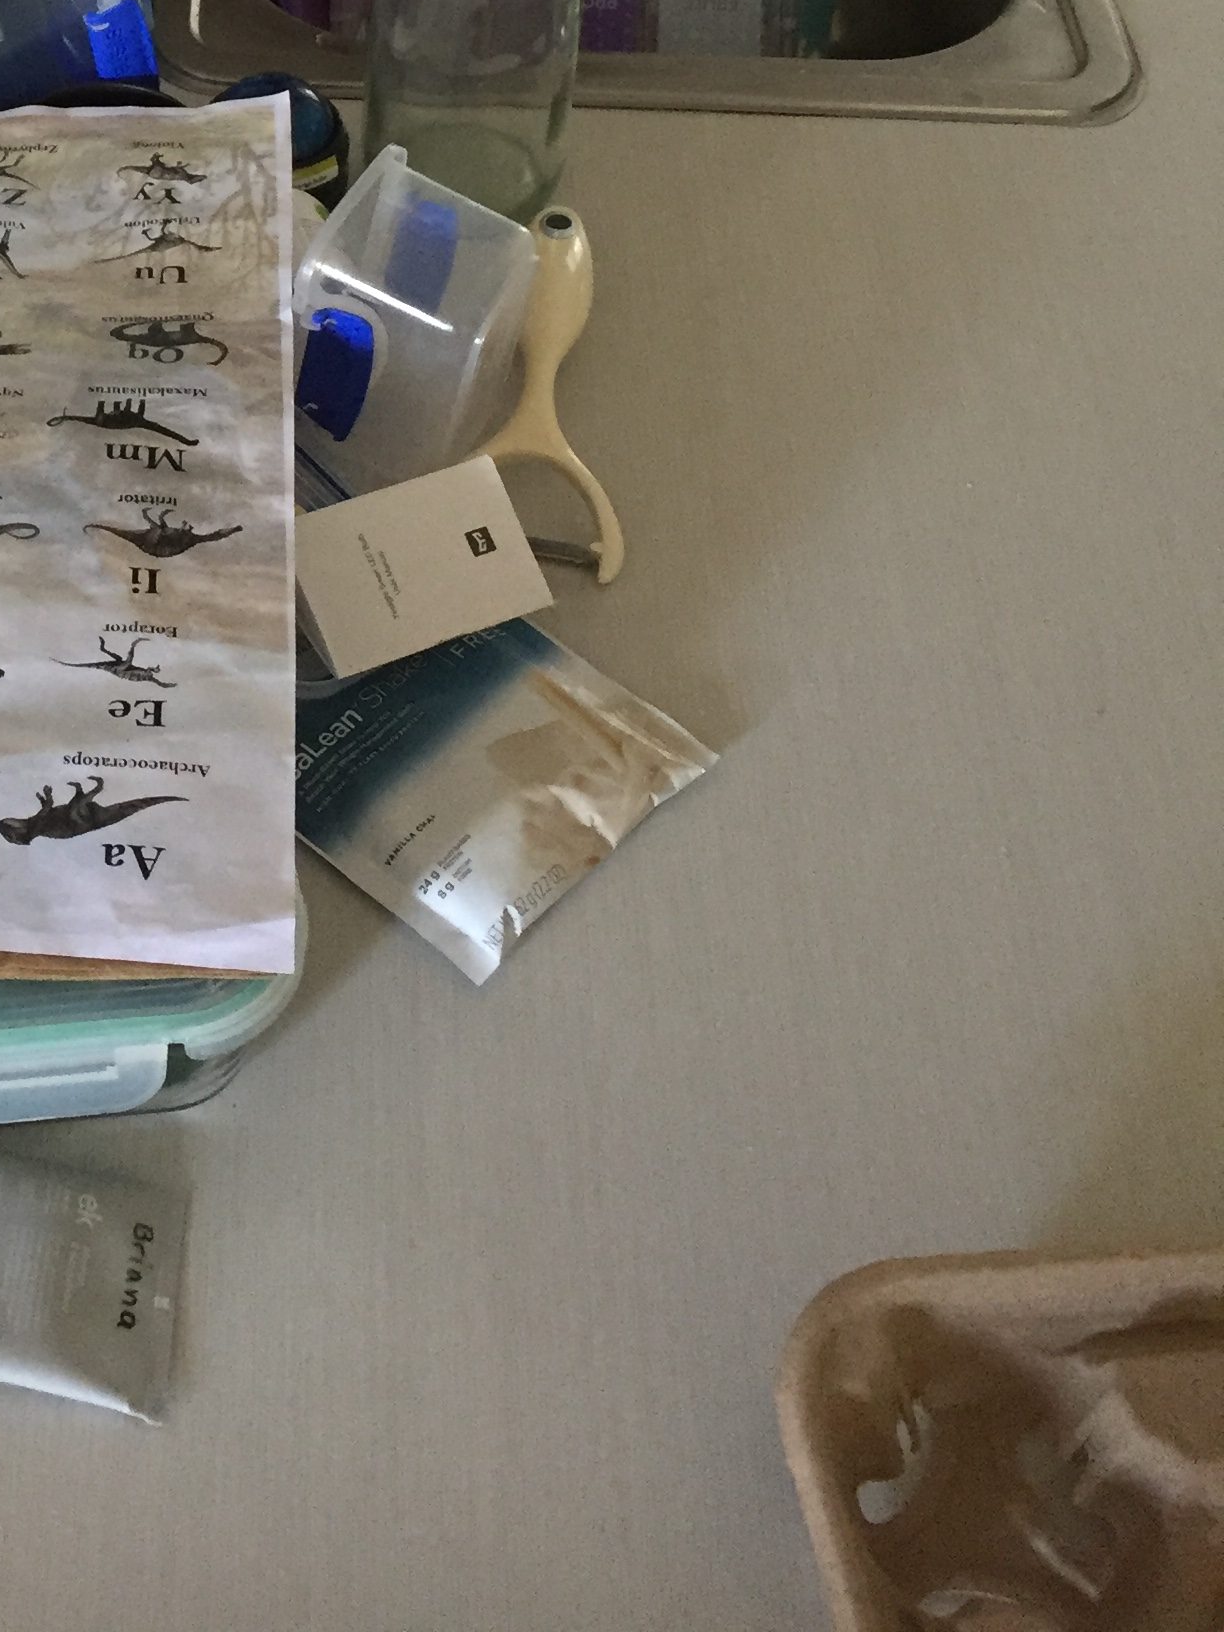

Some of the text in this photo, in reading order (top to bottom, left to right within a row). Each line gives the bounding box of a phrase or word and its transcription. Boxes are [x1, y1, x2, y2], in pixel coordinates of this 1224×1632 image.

[132, 181, 181, 205] Yy
[134, 265, 188, 285] Uu
[104, 442, 188, 473] Mm
[117, 493, 178, 508] Irritator
[128, 566, 162, 595] Ii
[102, 620, 178, 639] Eoraptor
[107, 699, 167, 729] Ee
[295, 706, 364, 780] aLean
[63, 753, 212, 779] Archaeoceratops
[384, 814, 436, 868] VANILLA CHAI
[101, 843, 167, 881] Aa
[437, 881, 456, 900] 8 g
[482, 924, 504, 951] NET
